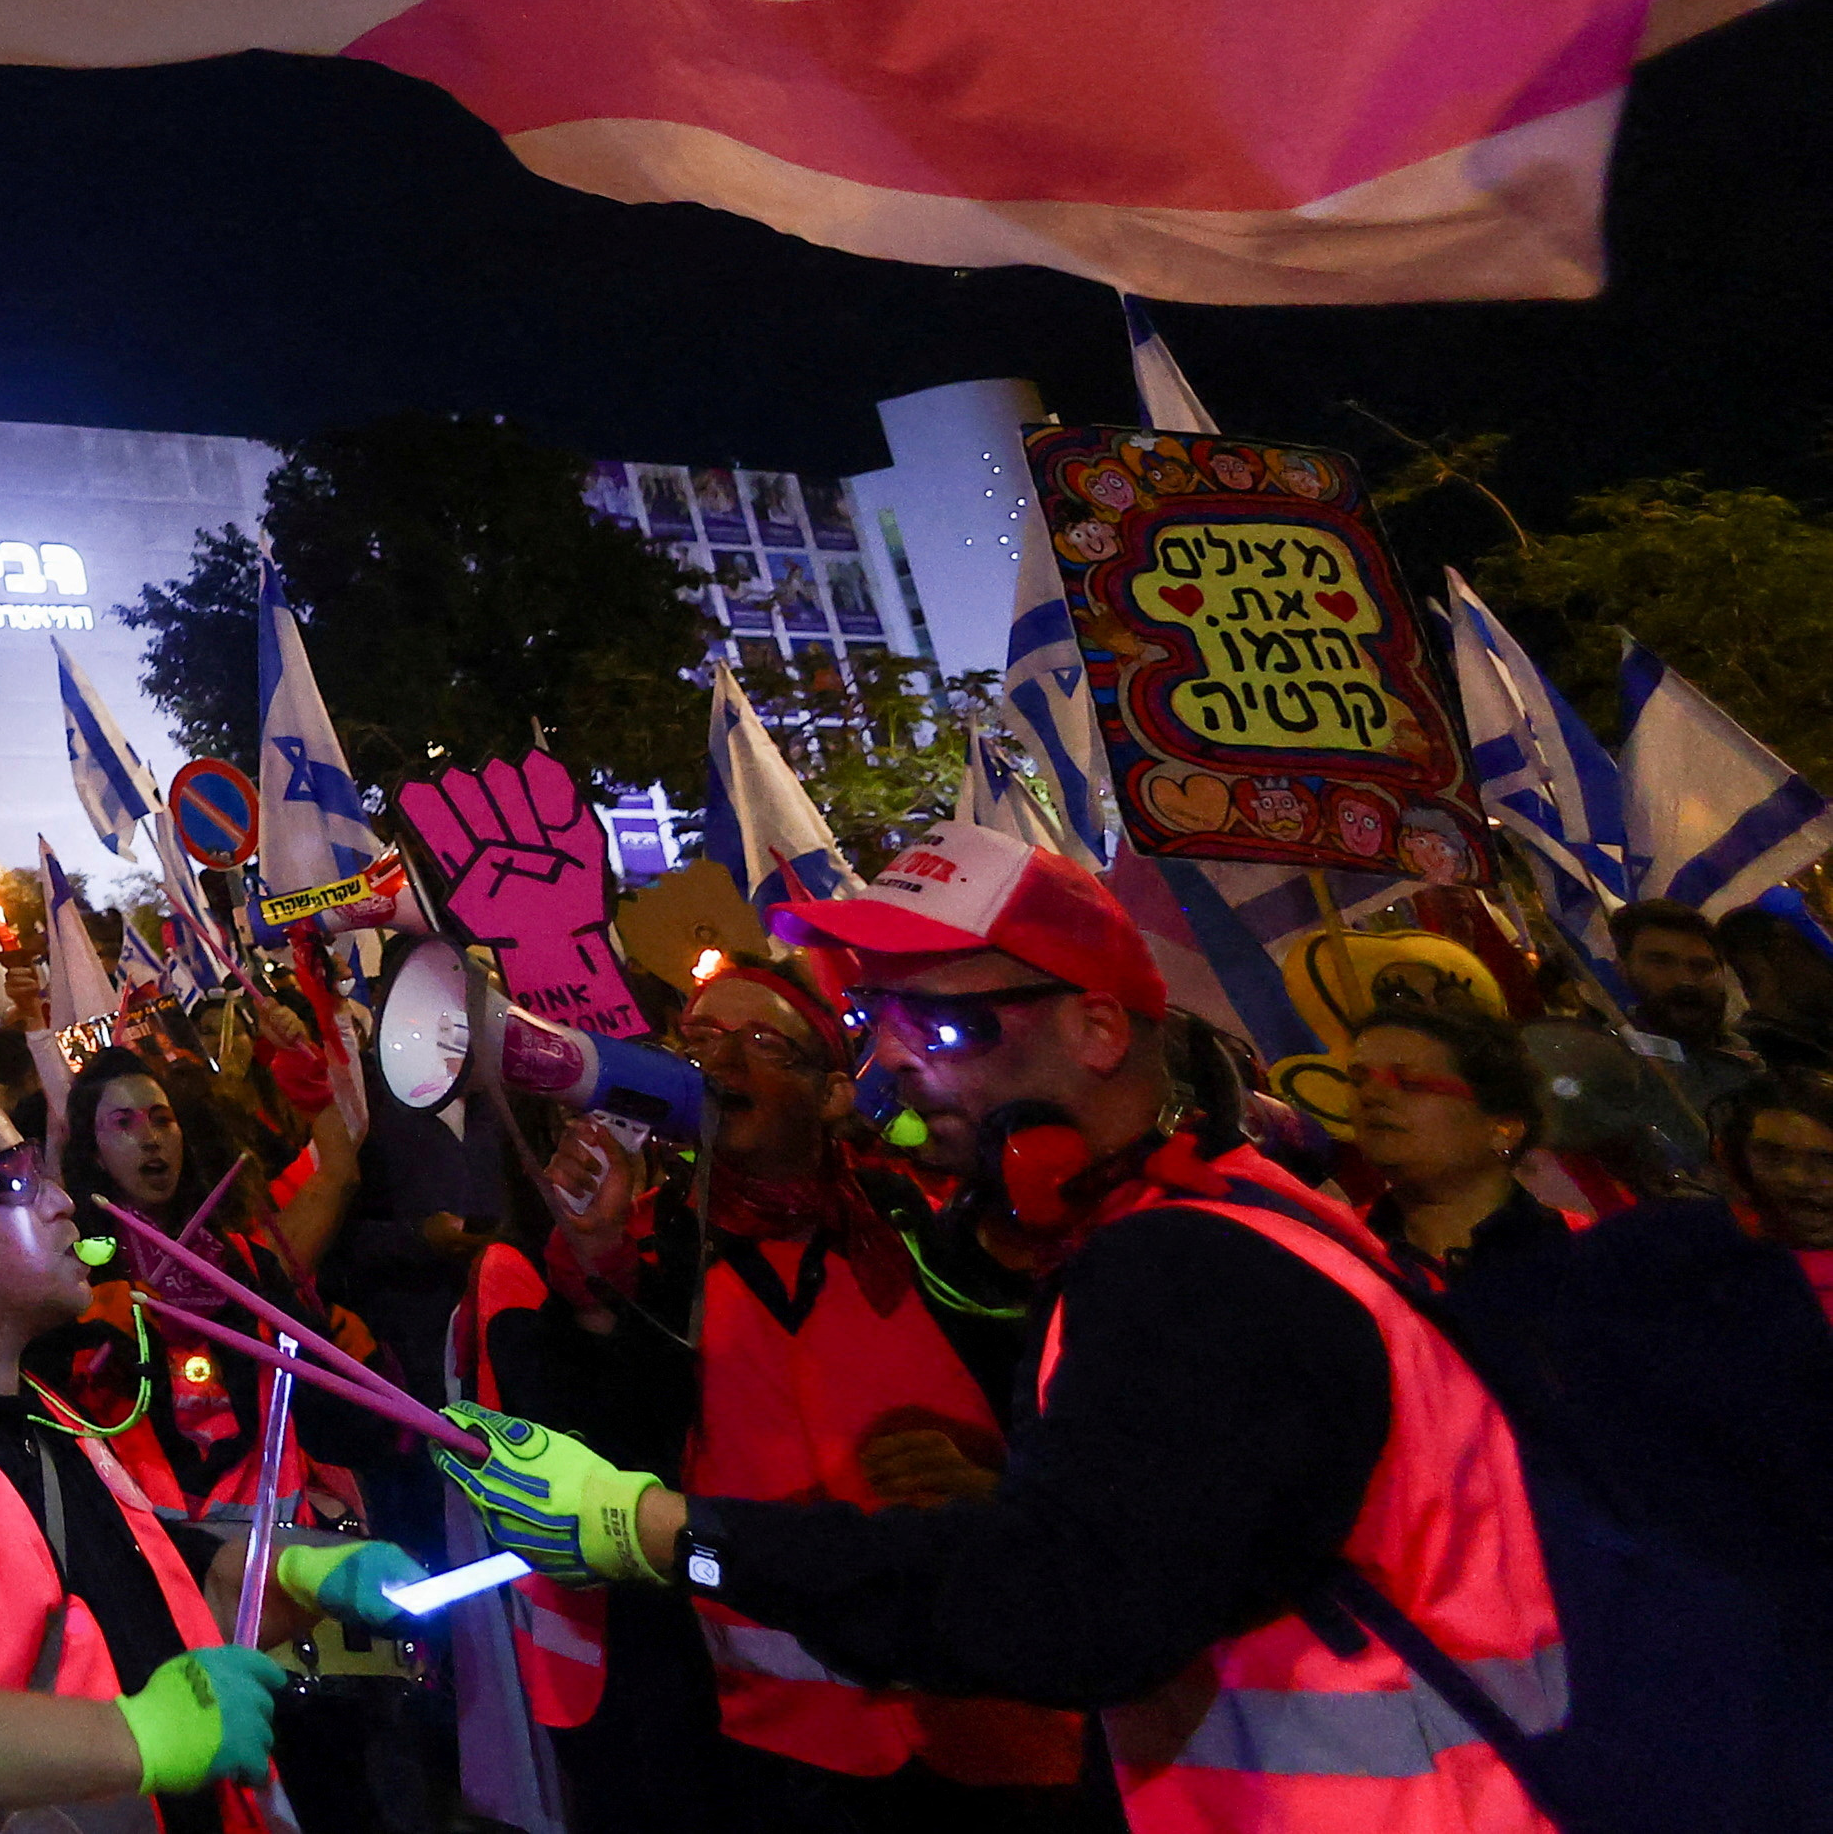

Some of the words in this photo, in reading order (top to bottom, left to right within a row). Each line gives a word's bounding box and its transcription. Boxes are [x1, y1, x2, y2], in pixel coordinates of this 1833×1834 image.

[1229, 587, 1310, 622] את
[1192, 681, 1388, 747] קרטיה
[320, 879, 361, 907] שקרן
[517, 983, 591, 1011] PINK
